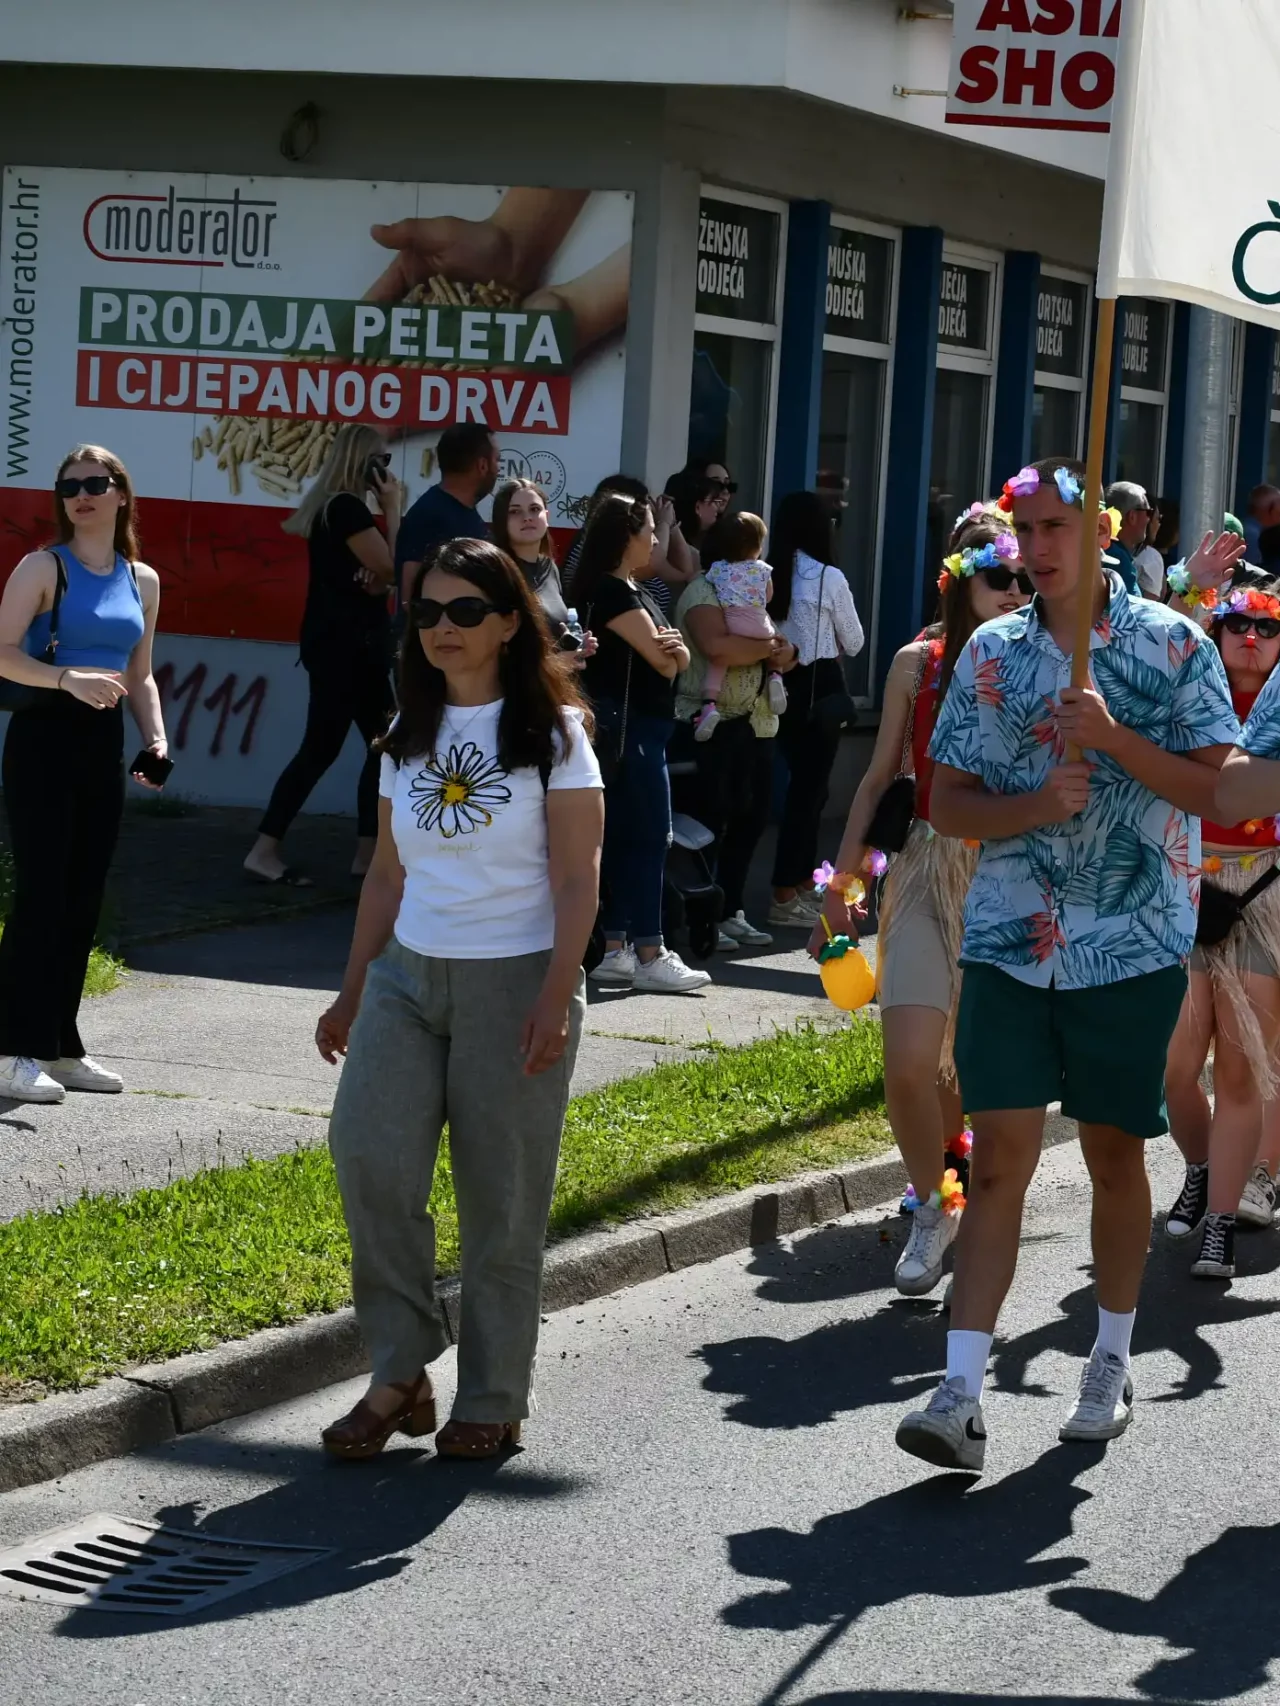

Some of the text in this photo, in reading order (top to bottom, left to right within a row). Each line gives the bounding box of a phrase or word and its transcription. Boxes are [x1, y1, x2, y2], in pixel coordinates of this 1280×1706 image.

[105, 185, 277, 268] moderator
[698, 211, 749, 260] ŽENSKA
[697, 258, 745, 299] ODJEĆA
[827, 243, 866, 283] MUŠKA
[824, 283, 864, 320] ODJEĆA
[6, 177, 40, 478] www.moderator.hr
[91, 292, 562, 365] PRODAJA PELETA
[87, 356, 559, 429] I CIJEPANOG DRVA
[534, 470, 552, 485] A2
